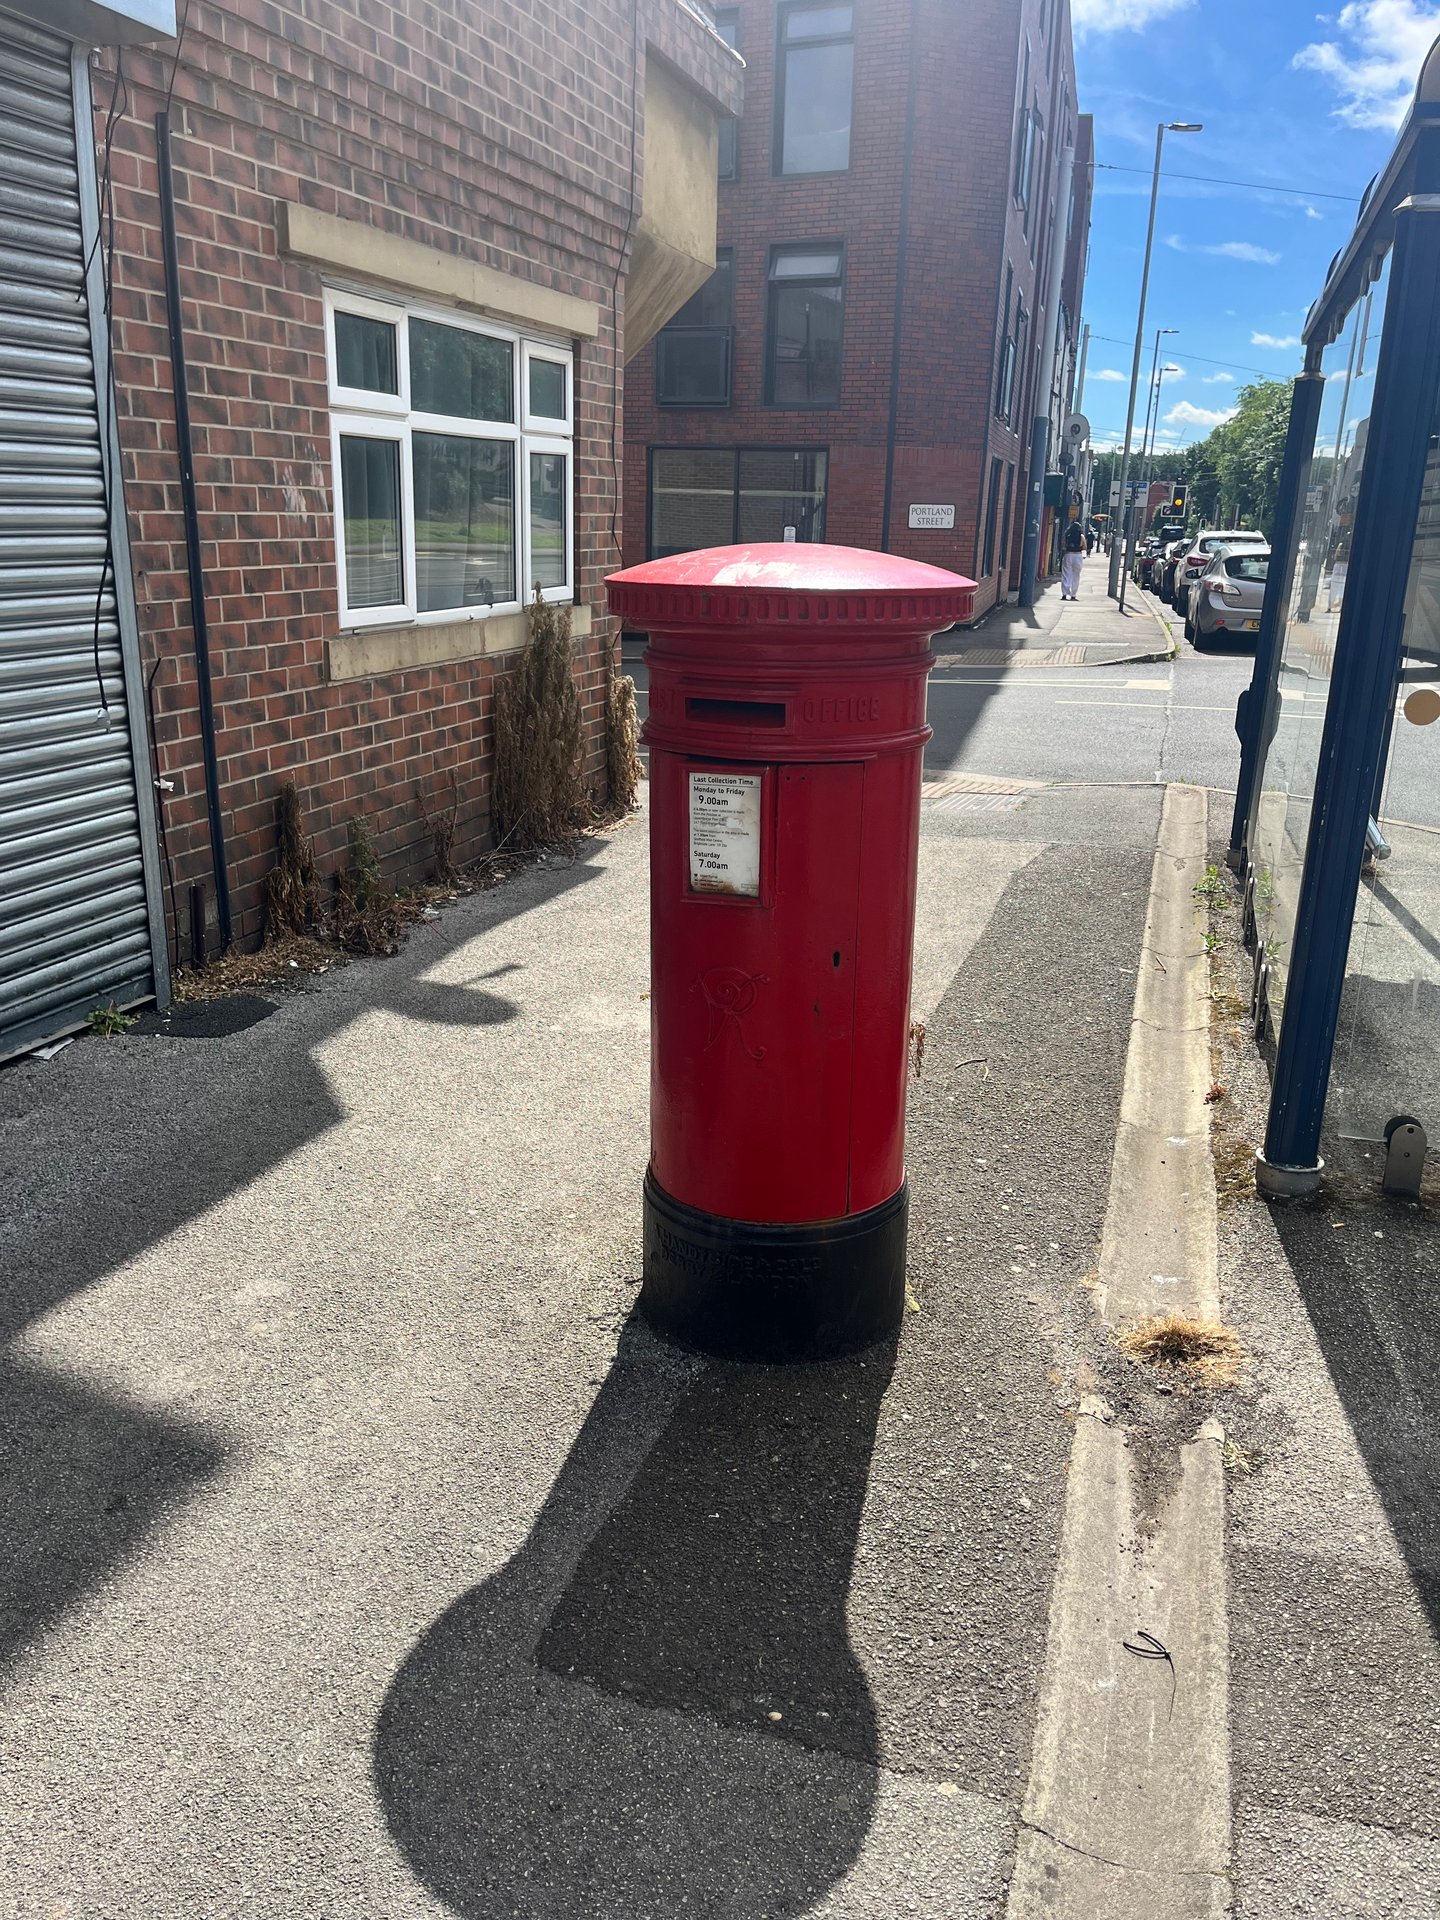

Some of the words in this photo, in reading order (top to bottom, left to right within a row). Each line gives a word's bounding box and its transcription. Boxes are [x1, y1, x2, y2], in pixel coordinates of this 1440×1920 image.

[911, 507, 953, 515] PORTLAND
[917, 517, 944, 525] STREET
[803, 697, 879, 724] OFFICE
[708, 776, 737, 785] Collection
[738, 778, 754, 786] Time
[693, 786, 716, 795] Monday
[726, 788, 745, 796] Friday
[698, 795, 729, 806] 9.00am
[693, 851, 720, 860] Saturday
[698, 859, 729, 870] 7.00am
